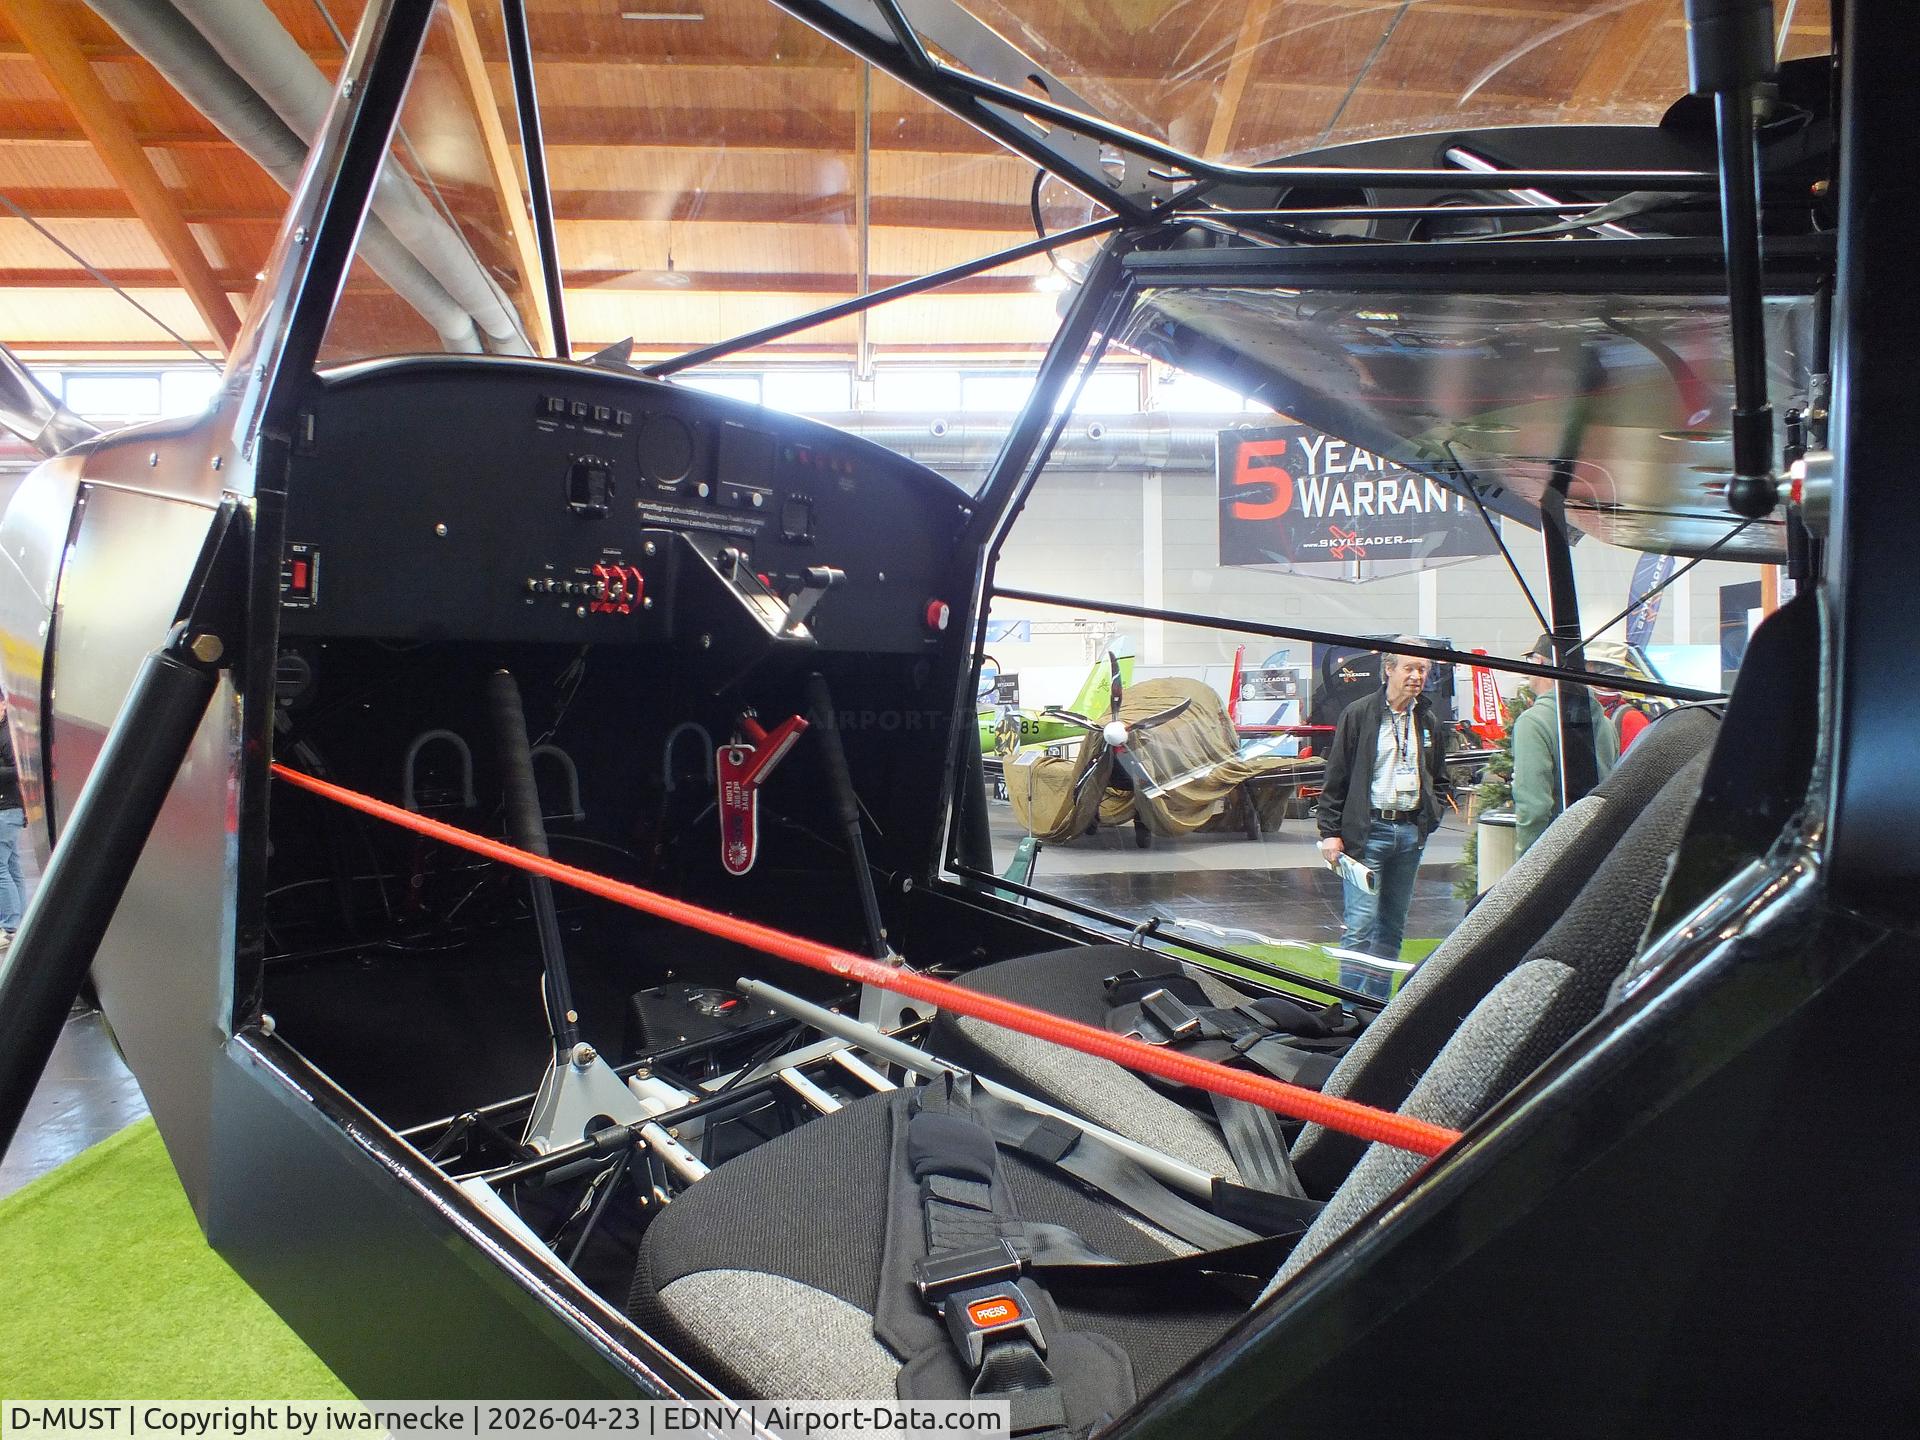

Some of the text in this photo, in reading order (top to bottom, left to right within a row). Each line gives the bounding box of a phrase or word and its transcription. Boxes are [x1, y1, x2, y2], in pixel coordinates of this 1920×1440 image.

[1232, 439, 1293, 520] 5
[726, 781, 734, 806] FLIGHT
[976, 1305, 1008, 1320] PRESS
